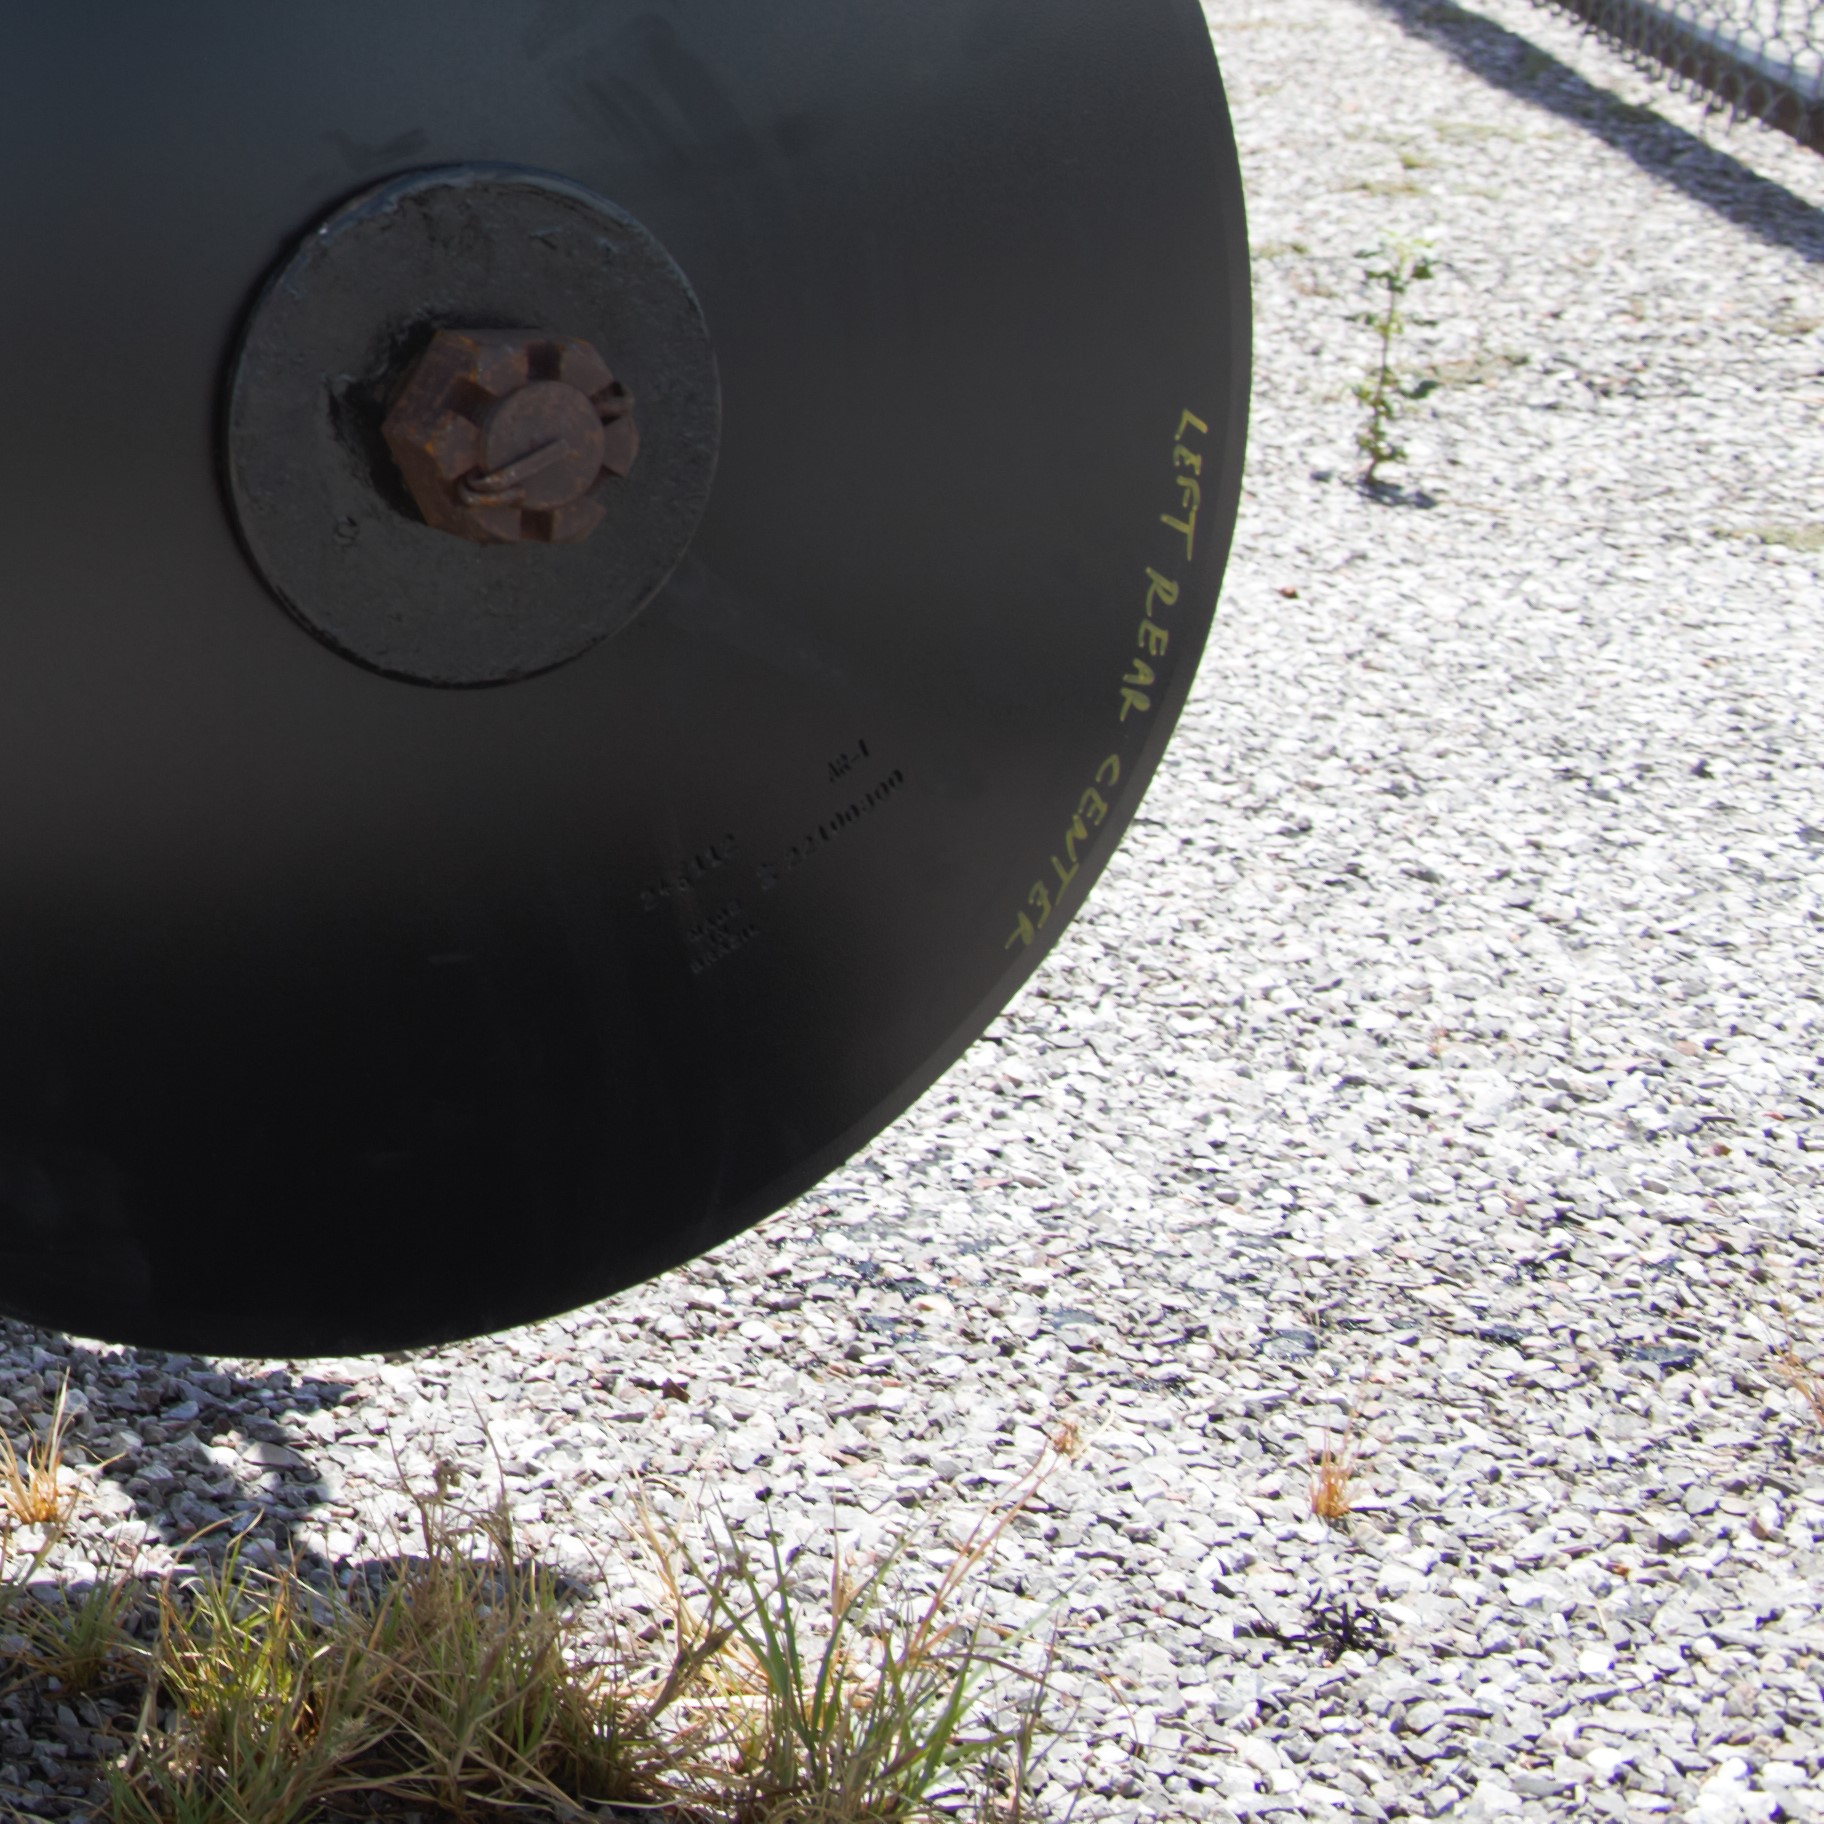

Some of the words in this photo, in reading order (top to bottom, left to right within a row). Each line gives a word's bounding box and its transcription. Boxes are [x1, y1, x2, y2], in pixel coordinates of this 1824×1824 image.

[1159, 408, 1207, 561] LEFT
[1119, 566, 1179, 722] REAR
[1005, 753, 1121, 950] CENTER
